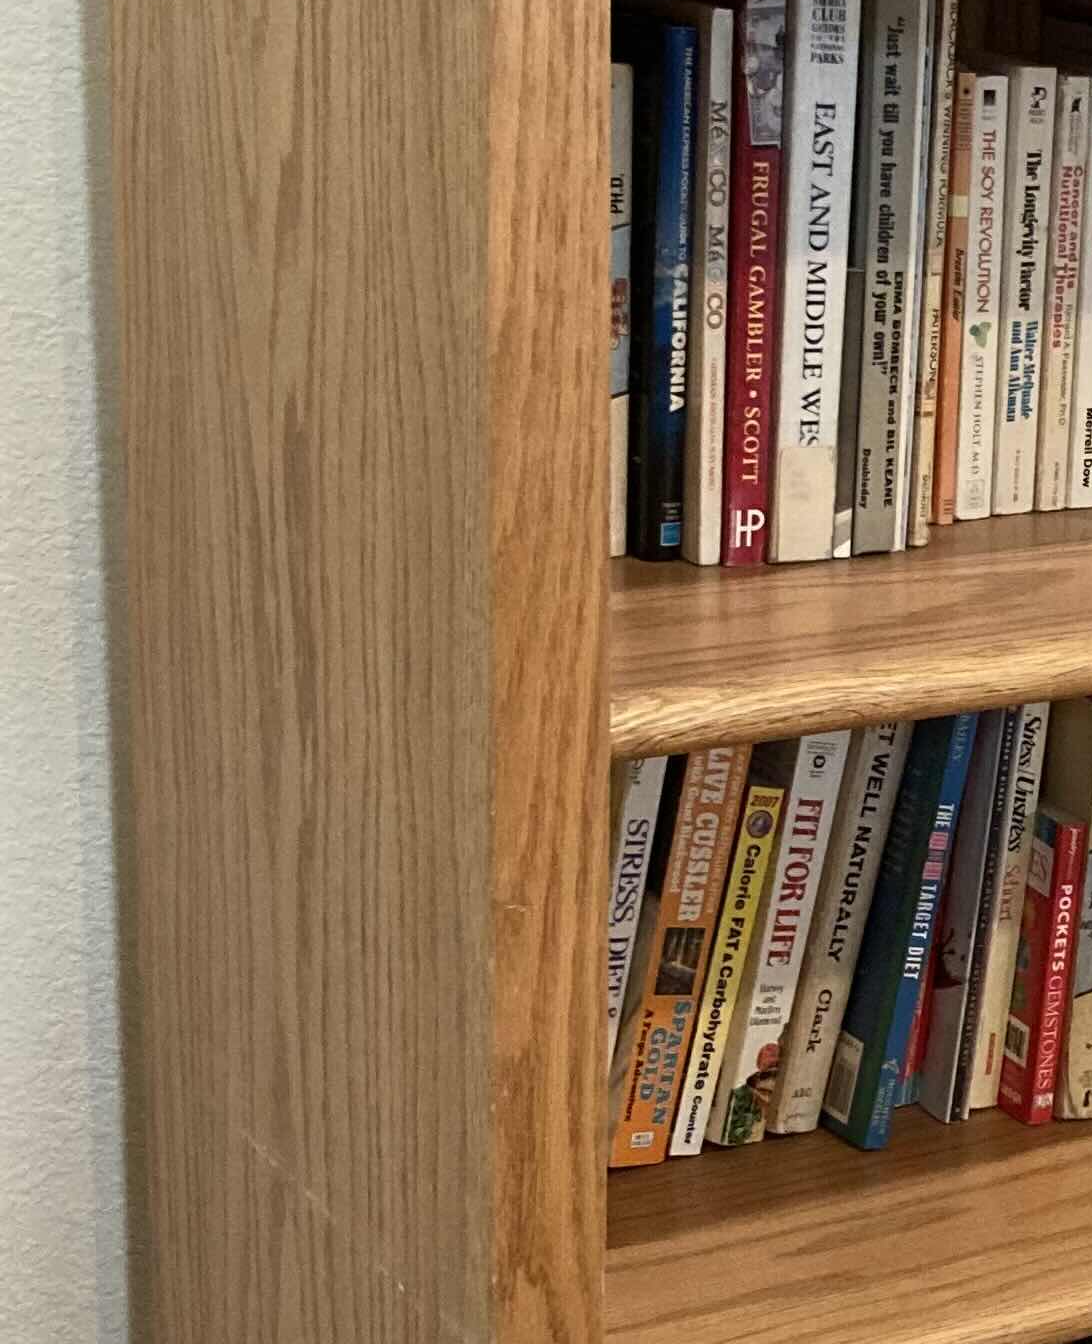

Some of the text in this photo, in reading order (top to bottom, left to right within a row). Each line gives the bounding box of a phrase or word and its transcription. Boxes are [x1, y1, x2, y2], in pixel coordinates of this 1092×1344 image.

[810, 52, 845, 64] PARKS
[811, 8, 848, 22] CLUB
[669, 264, 690, 413] CALIFORNIA
[741, 161, 770, 485] FRUGAL GAMBLER SCOTT
[882, 272, 904, 508] ERMA BOMBECK and BIL KEANE
[858, 449, 873, 509] Doubleday
[827, 755, 890, 961] WELL NATURALLY
[935, 804, 955, 828] THE
[766, 799, 825, 967] FIT FOR LIFE
[902, 885, 937, 980] TARGET DIET
[805, 989, 833, 1053] Clark
[1035, 884, 1073, 1089] POCKETS GEMSTONES
[639, 1027, 668, 1100] GOLD
